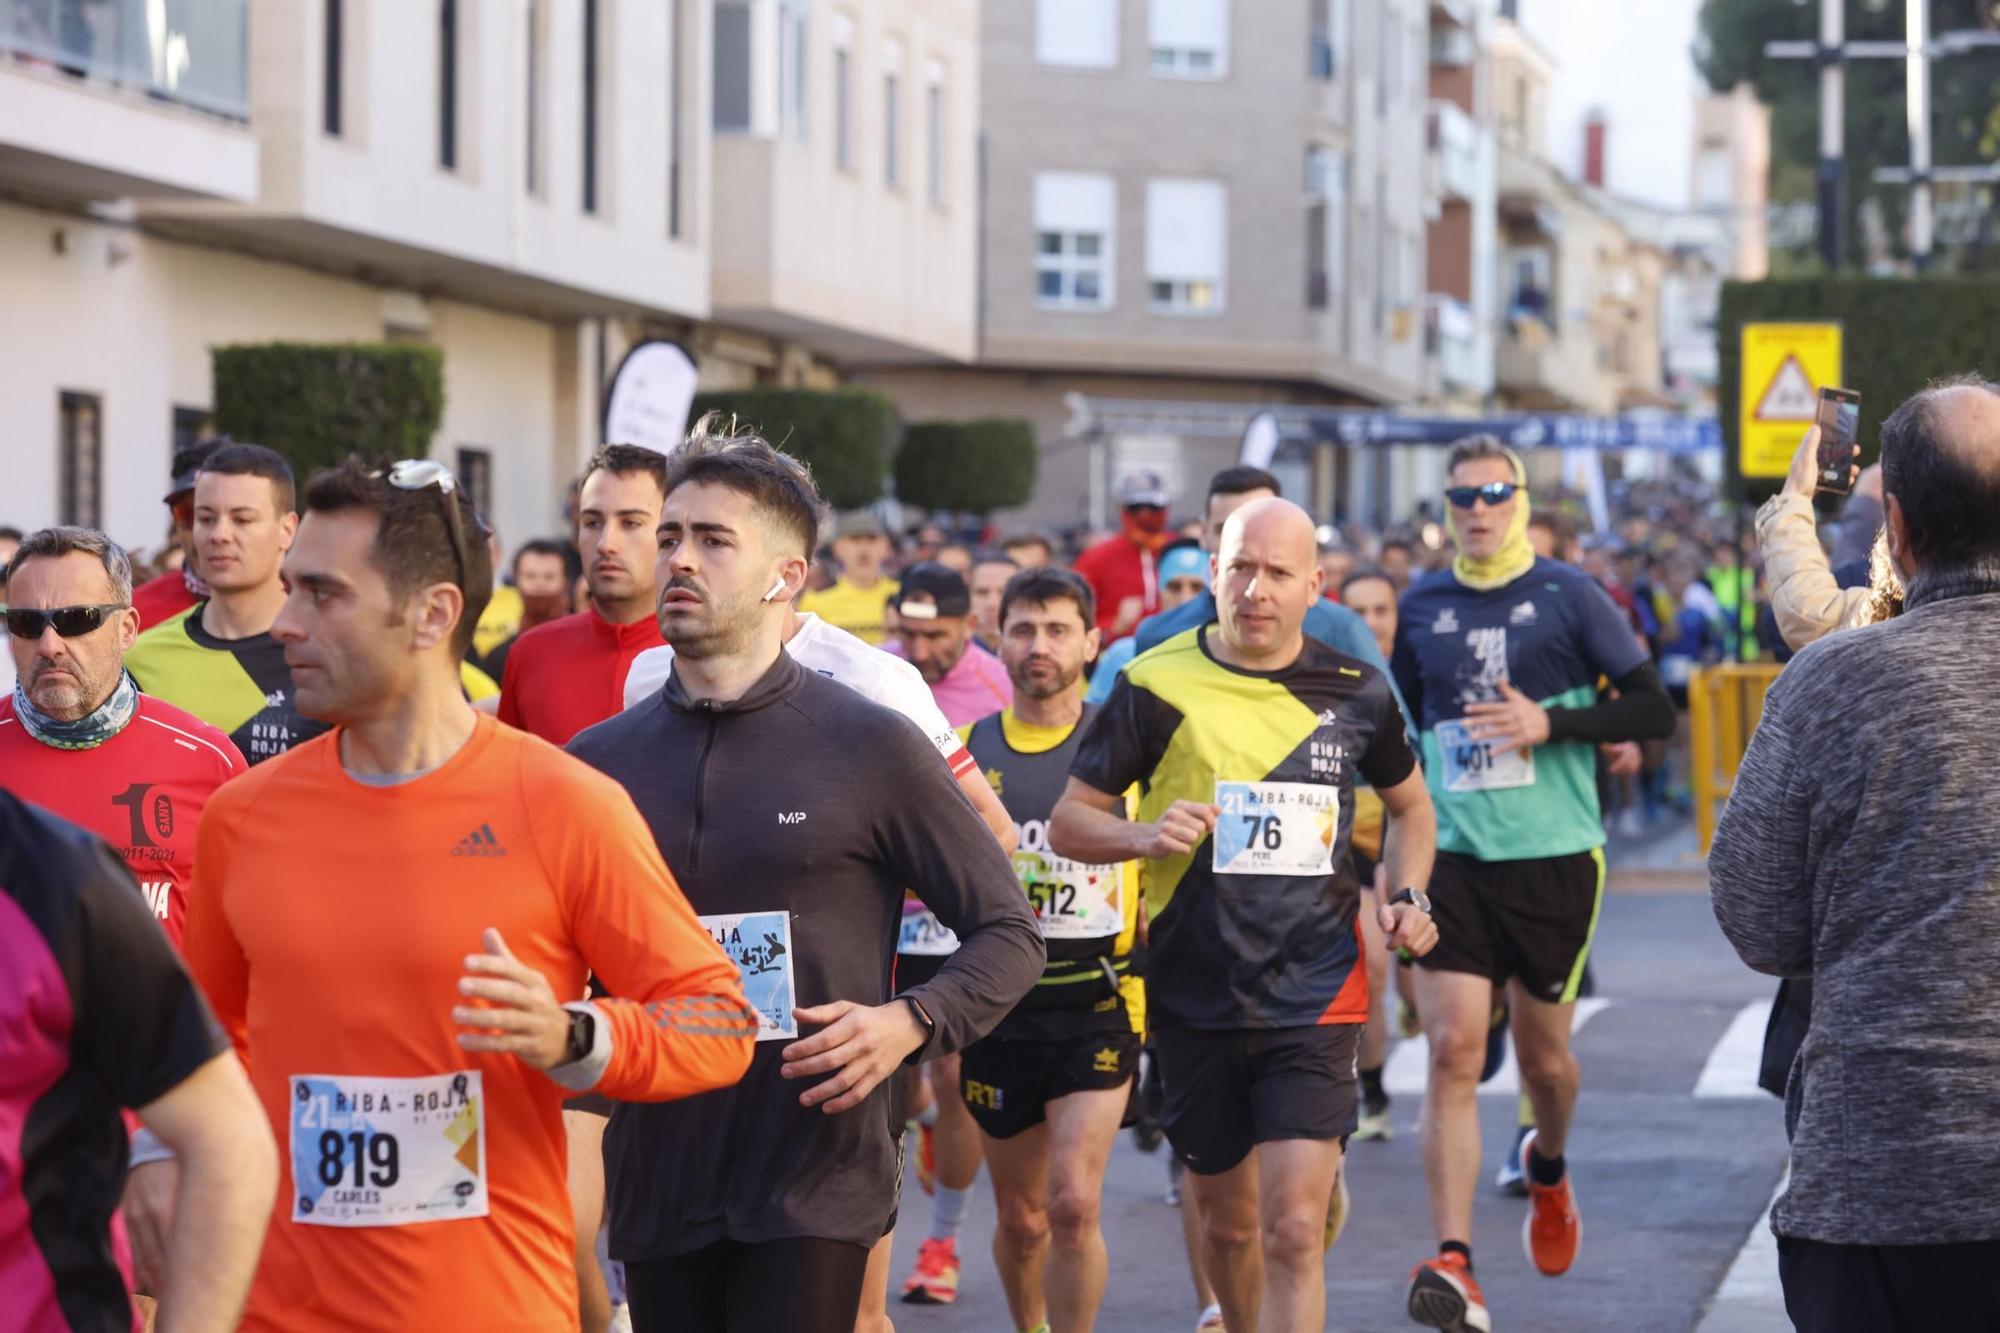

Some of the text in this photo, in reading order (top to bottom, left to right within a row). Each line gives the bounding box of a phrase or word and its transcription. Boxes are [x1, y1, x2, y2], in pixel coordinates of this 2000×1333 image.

[778, 812, 807, 824] MP
[1243, 815, 1282, 850] 76
[1028, 882, 1077, 916] 512
[301, 1095, 330, 1128] 21
[319, 1129, 399, 1188] 819
